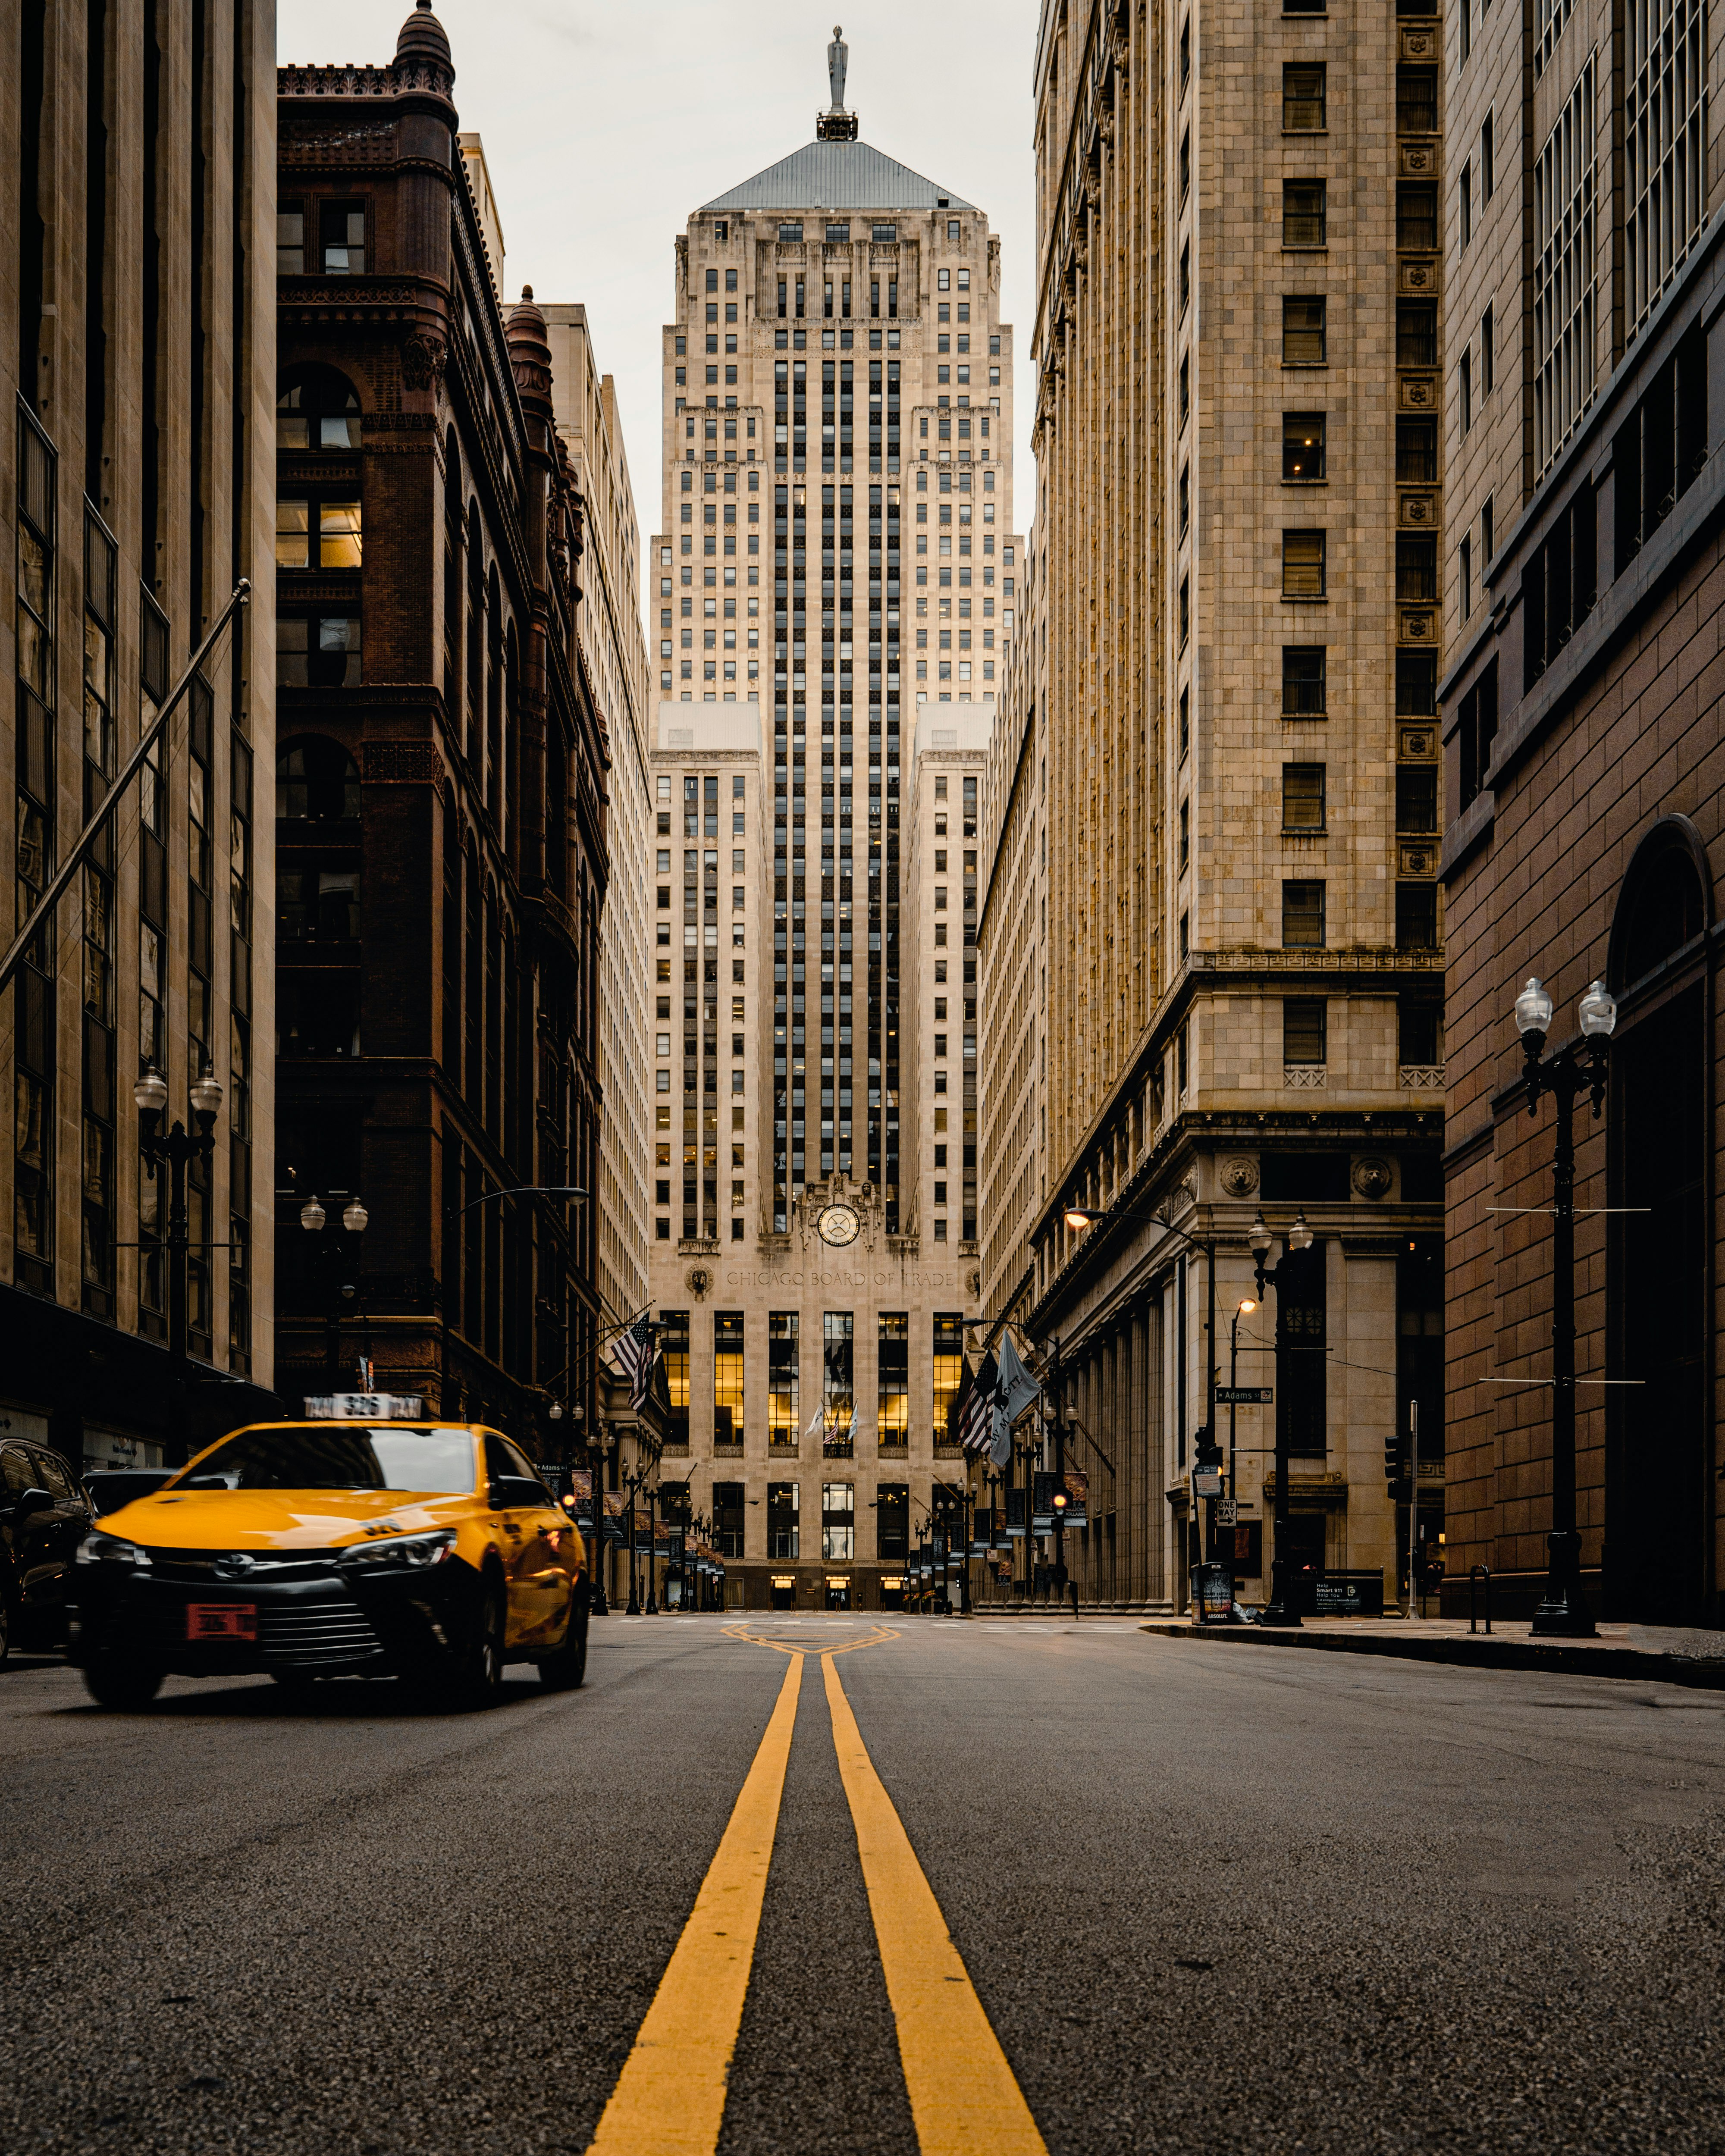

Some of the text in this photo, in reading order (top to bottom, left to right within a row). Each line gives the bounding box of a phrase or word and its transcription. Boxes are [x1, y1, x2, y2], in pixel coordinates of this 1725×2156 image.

[727, 1272, 953, 1286] CHICAGO BOARD OF TRADE
